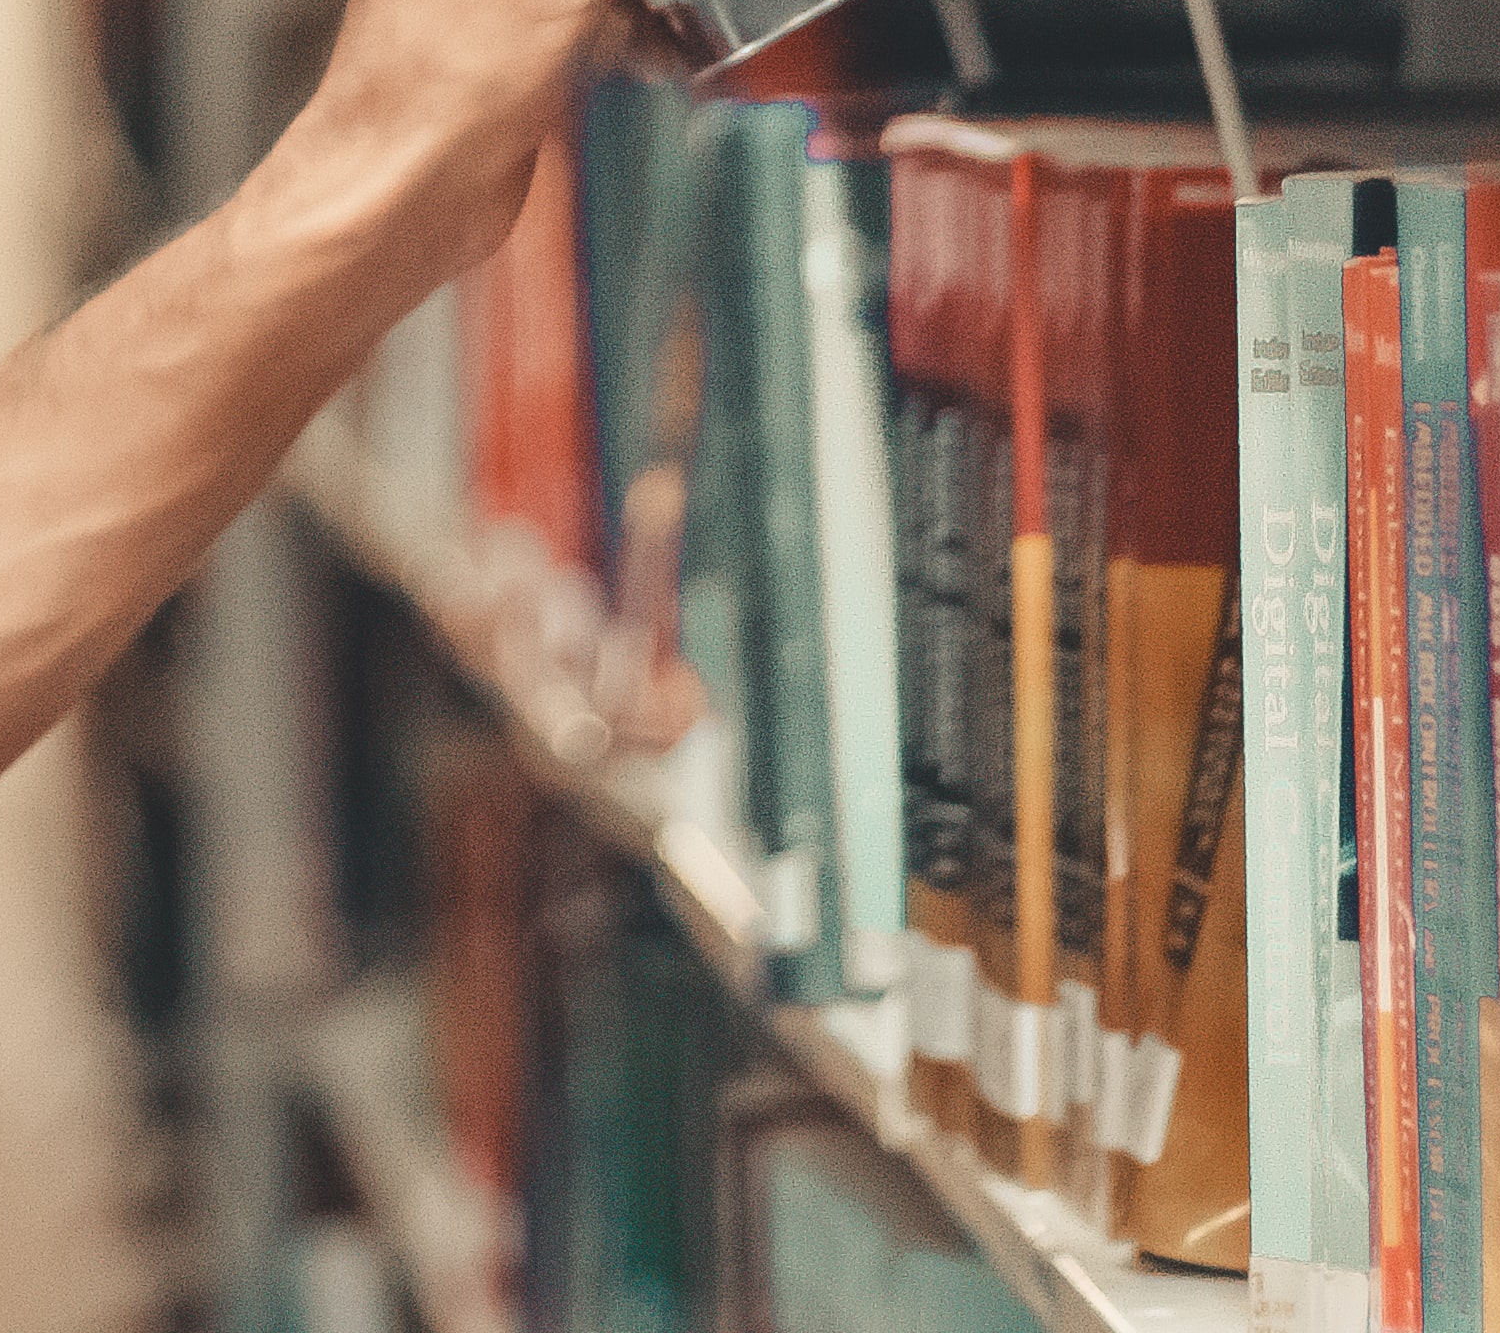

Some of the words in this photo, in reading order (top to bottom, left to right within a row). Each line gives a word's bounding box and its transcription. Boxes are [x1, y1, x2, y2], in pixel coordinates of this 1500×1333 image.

[1413, 400, 1434, 579] EMBEDDED
[1252, 501, 1299, 751] Digital
[1305, 500, 1338, 750] Digital
[1266, 779, 1300, 1067] Control
